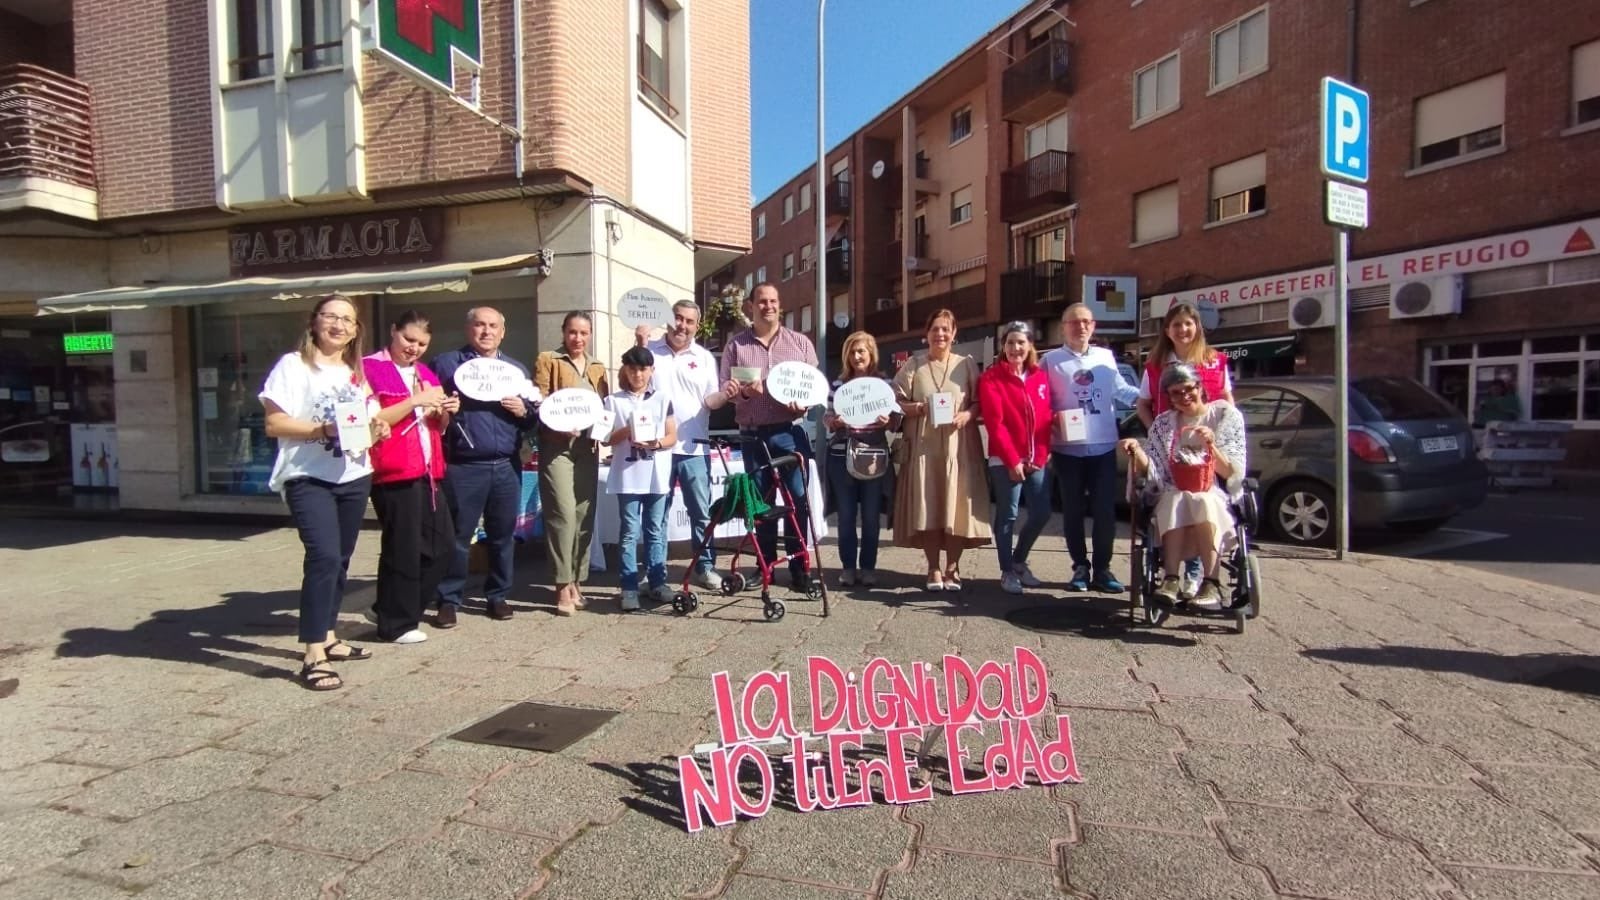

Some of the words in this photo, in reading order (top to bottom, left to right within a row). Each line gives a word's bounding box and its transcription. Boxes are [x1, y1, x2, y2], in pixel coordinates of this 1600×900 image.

[1335, 92, 1361, 164] P
[231, 217, 433, 267] FARMACIA
[1239, 269, 1350, 300] CAFETERÍ
[1362, 264, 1388, 282] EL
[1403, 239, 1531, 276] REFUGIO
[64, 335, 113, 351] ABIERTO
